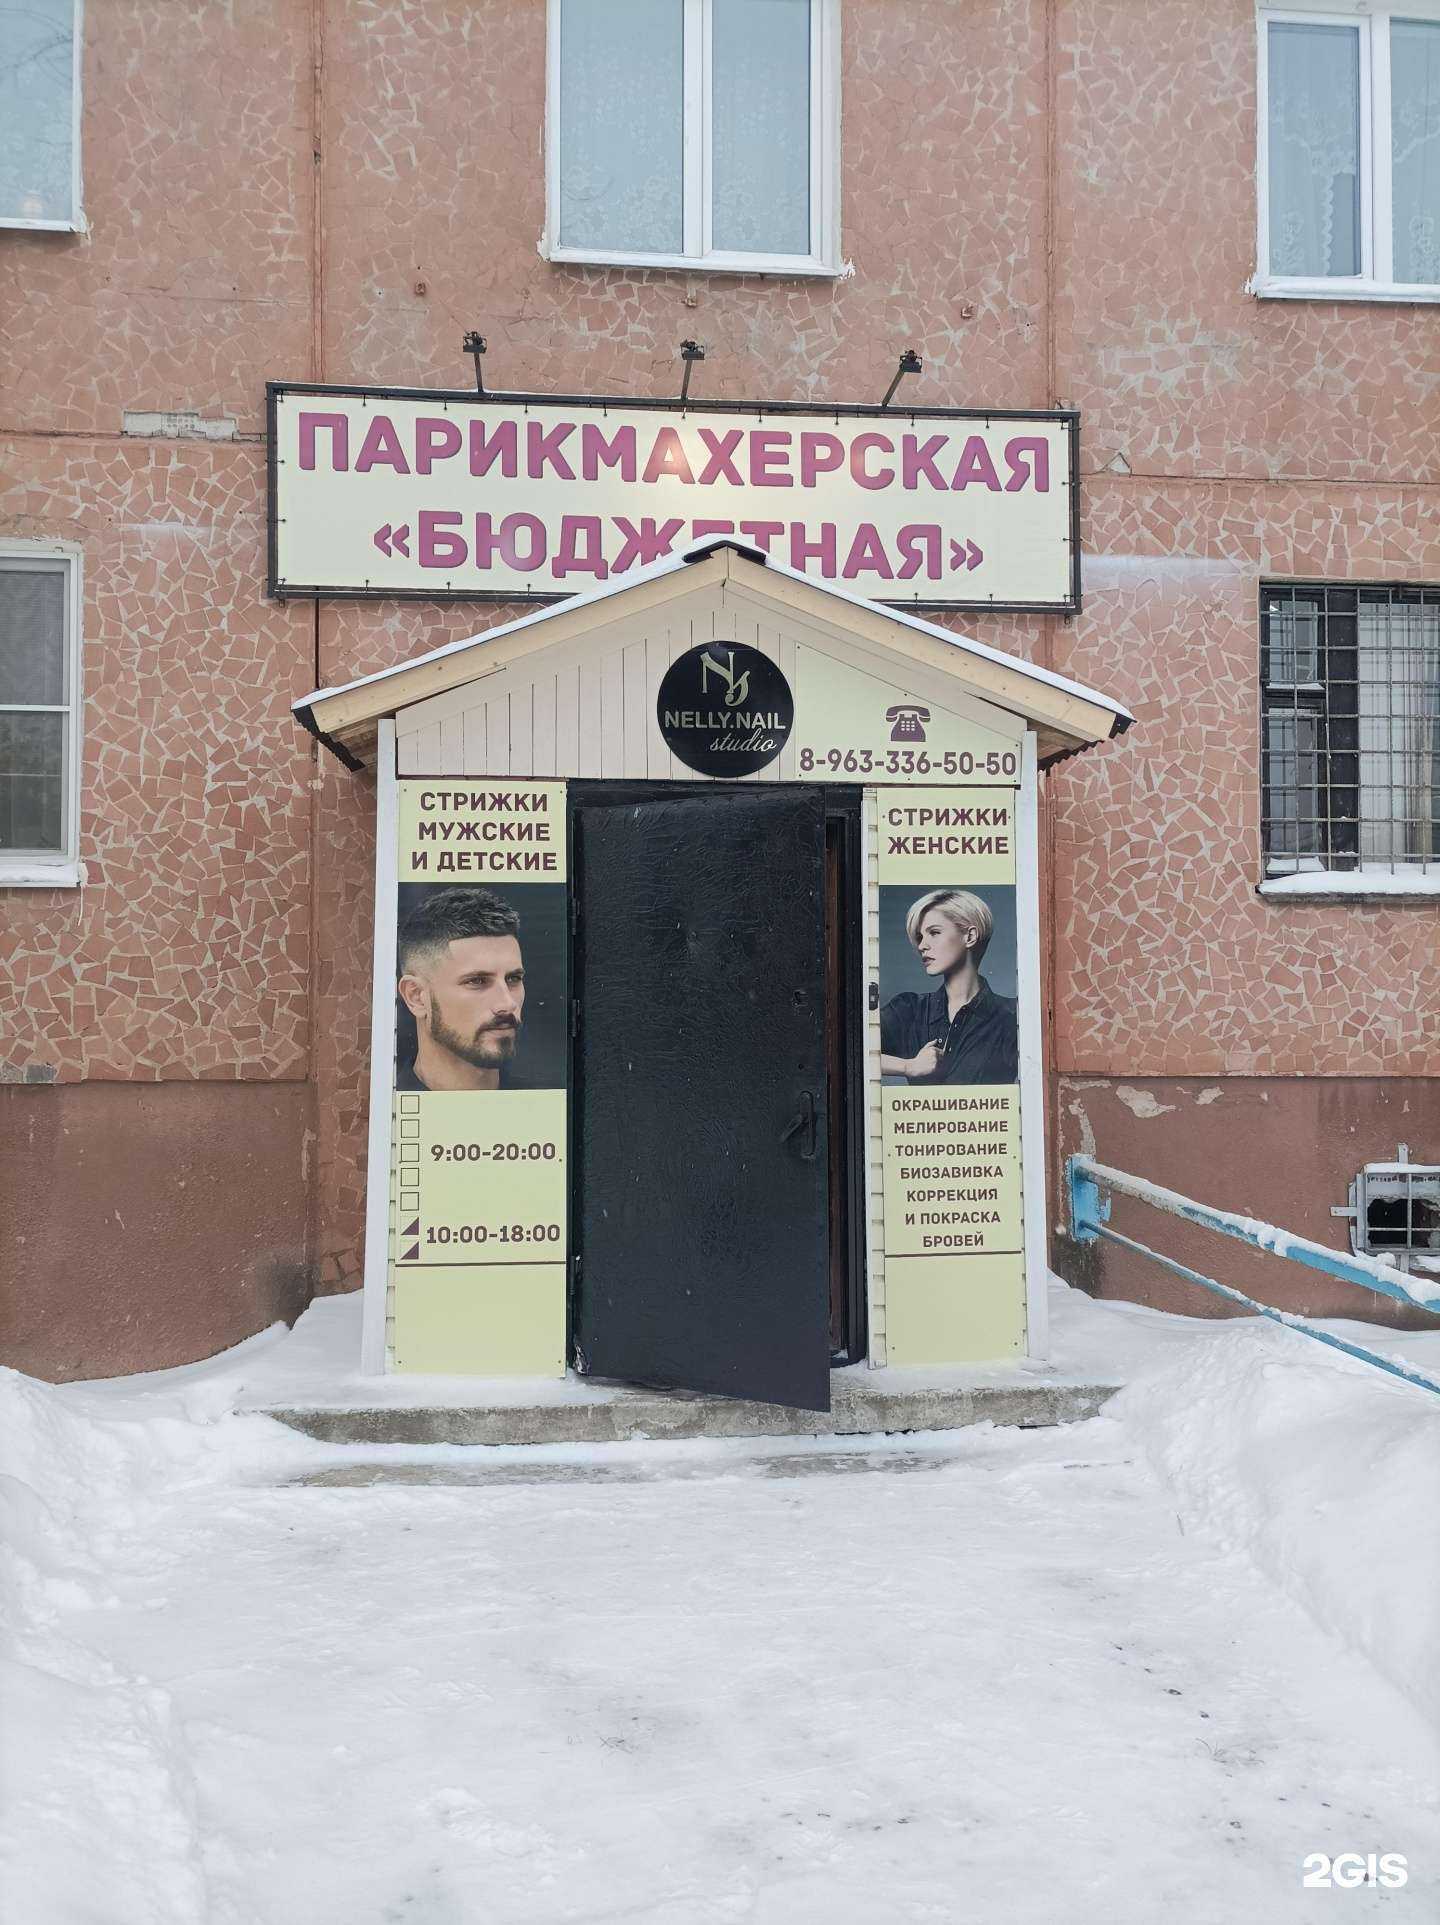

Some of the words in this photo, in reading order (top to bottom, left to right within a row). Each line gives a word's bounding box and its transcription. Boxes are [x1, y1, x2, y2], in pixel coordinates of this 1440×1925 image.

[298, 412, 1050, 493] ПАРИКМАХЕРСКАЯ
[709, 727, 778, 752] studio
[800, 747, 1017, 776] 8-963-336-50-50
[420, 792, 548, 812] СТРИЖКИ
[888, 807, 1008, 827] СТРИЖКИ
[418, 821, 551, 842] МУЖСКИЕ
[887, 836, 1009, 855] ЖЕНСКИЕ
[411, 851, 428, 870] И
[437, 851, 558, 872] ДЕТСКИЕ
[891, 1098, 1010, 1112] ОКРАШИВАНИЕ
[893, 1120, 1009, 1135] МЕЛИРОВАНИЕ
[430, 1142, 556, 1162] 9:00-20:00
[895, 1143, 1008, 1157] ТОНИРОВАНИЕ
[900, 1165, 1004, 1180] БИОЗАВИВКА
[906, 1188, 998, 1203] КОРРЕКЦИЯ
[905, 1213, 915, 1226] И
[920, 1211, 1001, 1226] ПОКРАСКА
[426, 1224, 561, 1244] 10:00-18:00
[922, 1231, 984, 1248] БРОВЕЙ
